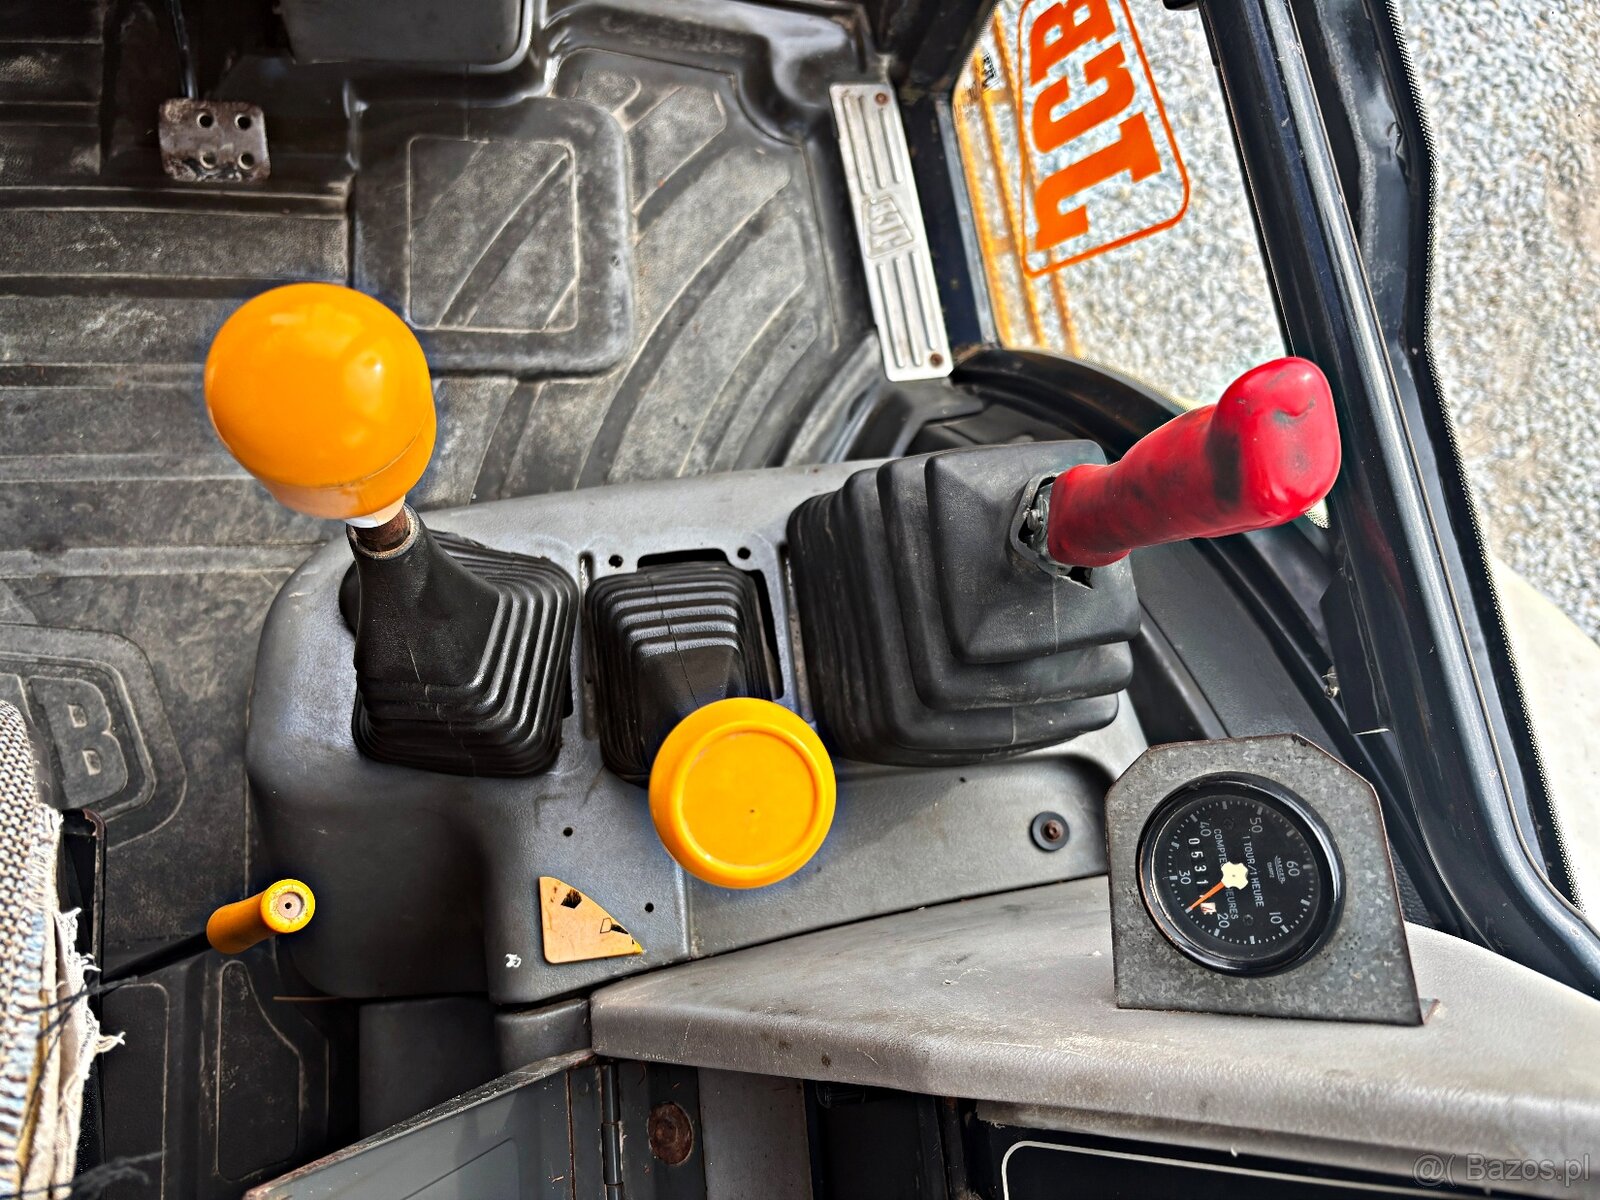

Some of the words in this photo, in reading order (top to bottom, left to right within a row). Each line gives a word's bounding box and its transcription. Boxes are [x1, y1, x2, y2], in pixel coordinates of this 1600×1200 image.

[1200, 821, 1212, 837] 40
[1250, 817, 1263, 833] 50
[1213, 828, 1228, 867] COMPTE
[1286, 860, 1300, 877] 60
[1179, 869, 1191, 885] 30
[1251, 877, 1264, 907] HEURE
[1217, 913, 1230, 928] 20
[1269, 911, 1283, 924] 10
